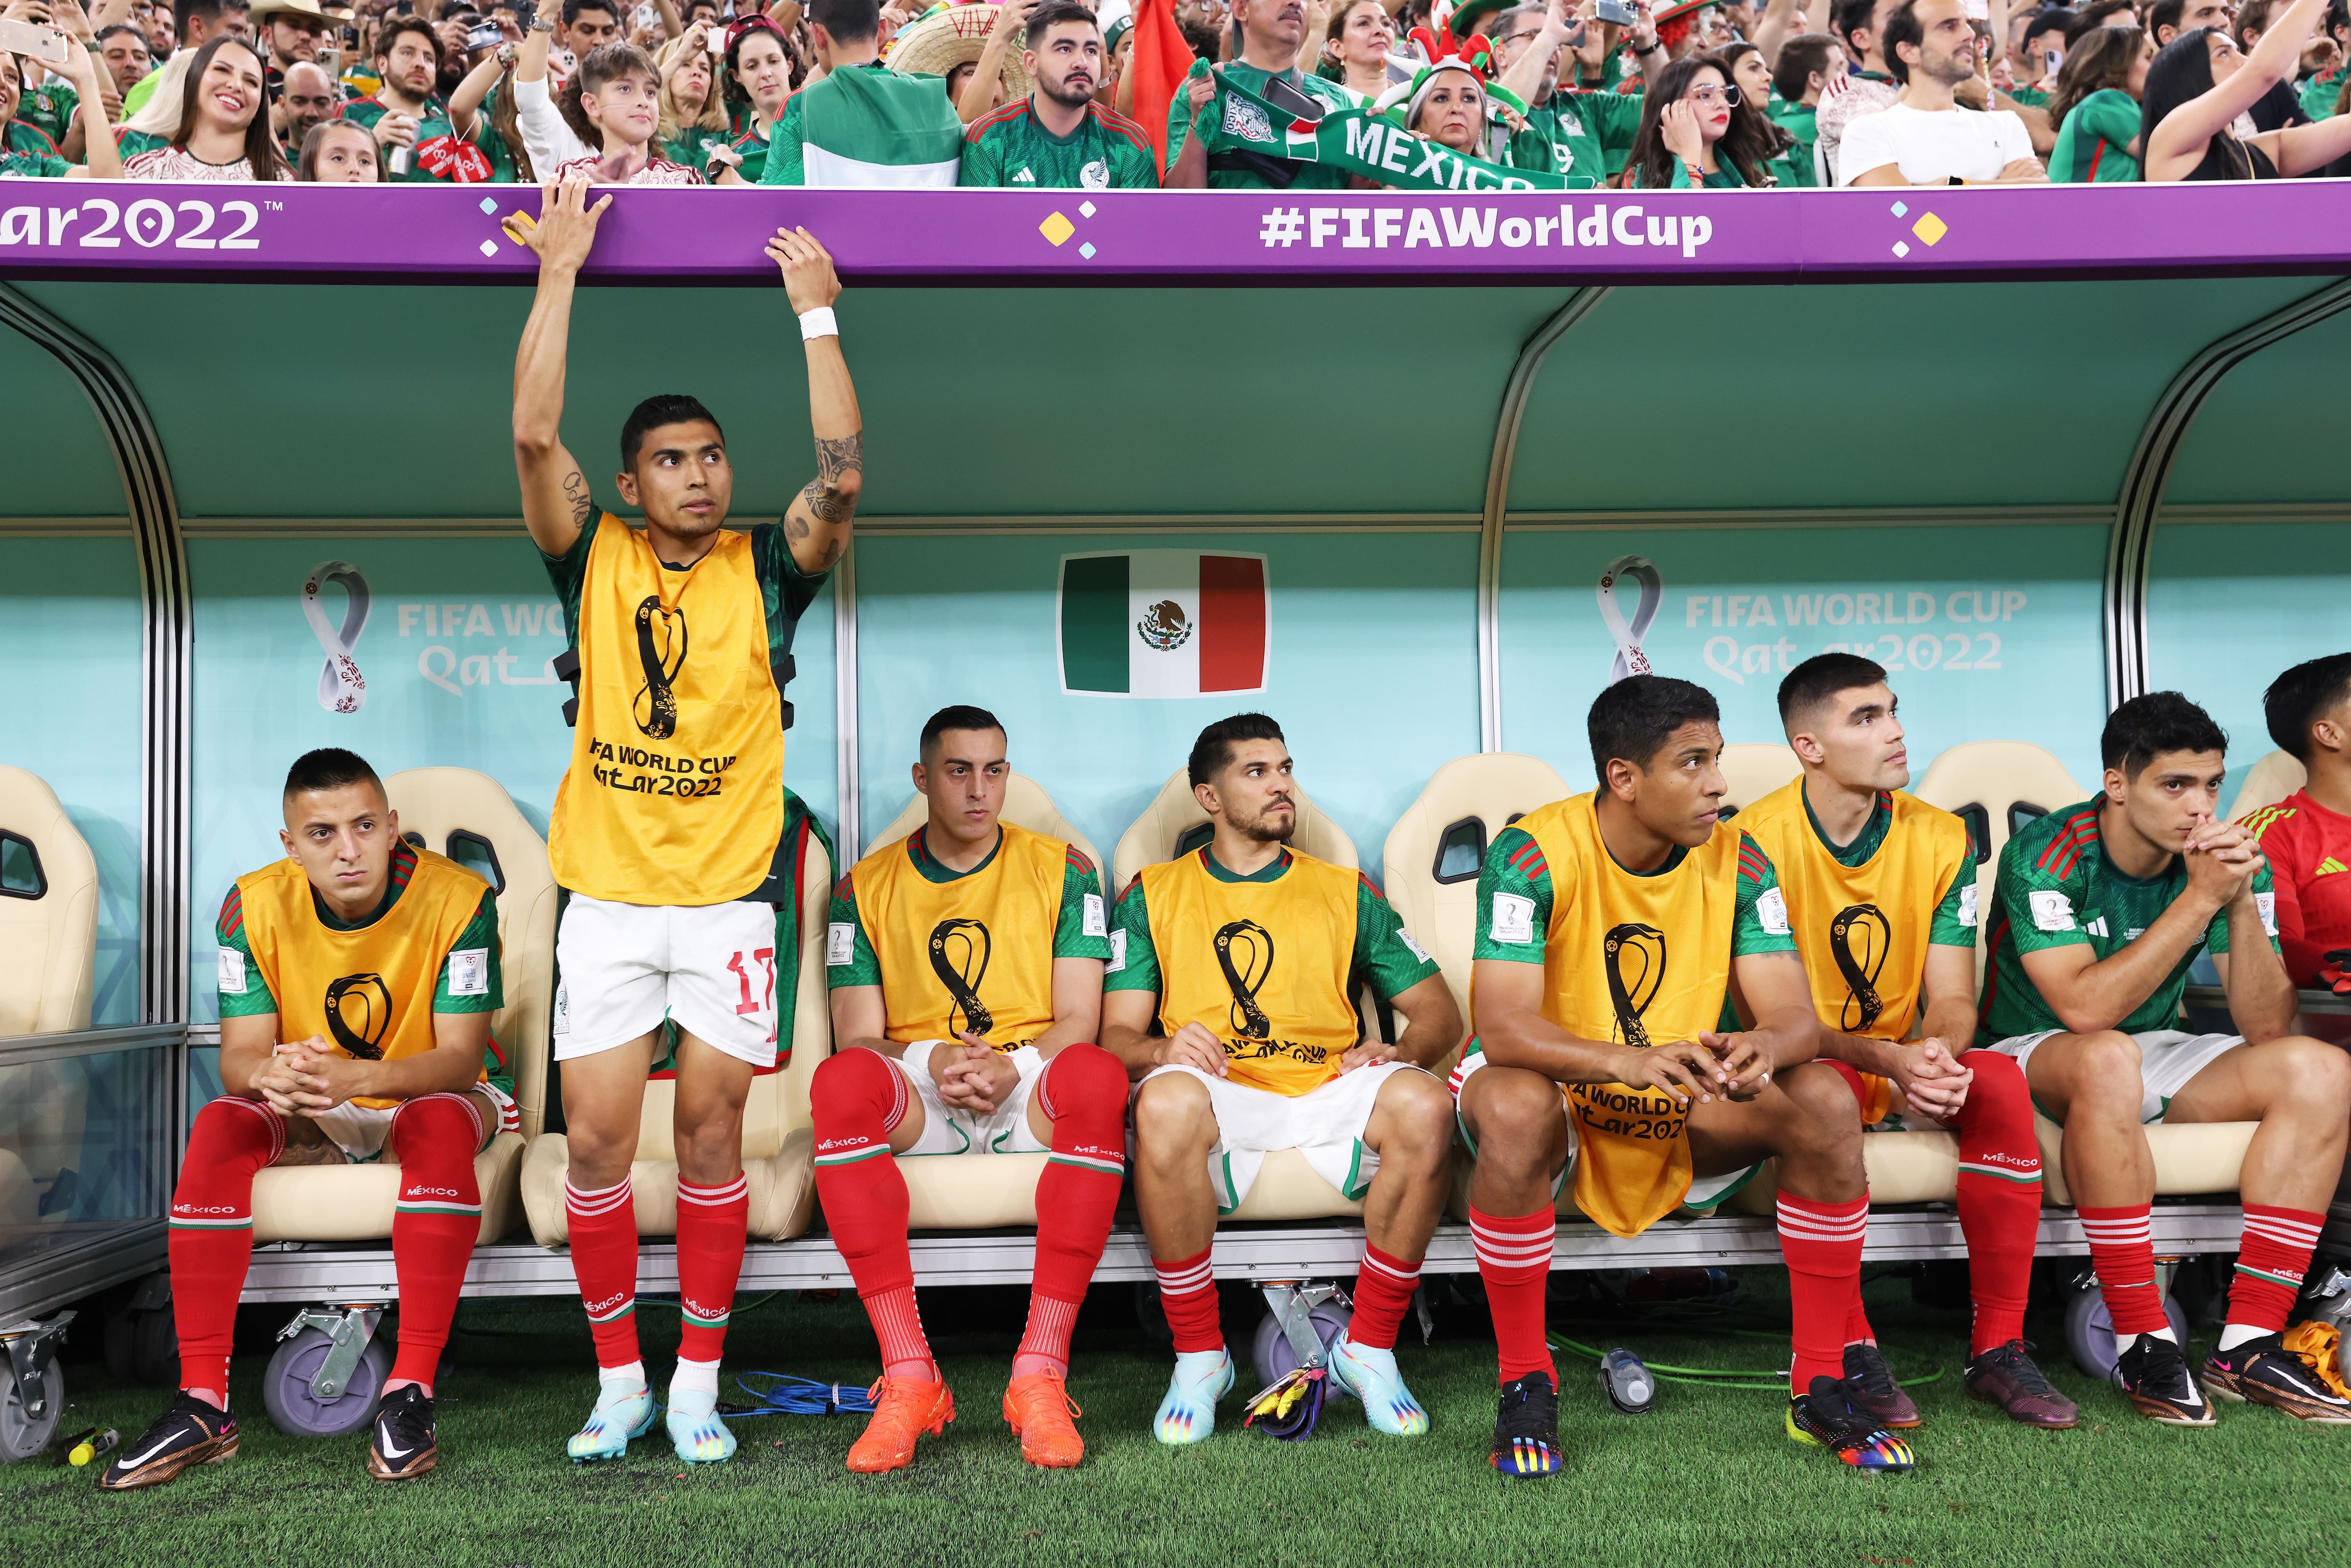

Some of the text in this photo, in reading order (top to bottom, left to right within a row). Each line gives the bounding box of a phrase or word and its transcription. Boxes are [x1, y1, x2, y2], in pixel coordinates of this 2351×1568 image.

[1259, 204, 1713, 258] #FIFAWorldCup
[398, 604, 496, 637] FIFA
[1686, 590, 2027, 628] FIFA WORLD CUP
[619, 745, 694, 773] WORLD
[699, 756, 737, 774] CUP
[726, 947, 773, 1016] 17
[1591, 1084, 1671, 1116] WORLD
[818, 1136, 869, 1151] MÉXICO
[1982, 1153, 2038, 1167] MÉXICO
[406, 1185, 458, 1197] MÉXICO
[174, 1204, 236, 1213] MÉXICO
[686, 1297, 726, 1317] MÉXICO
